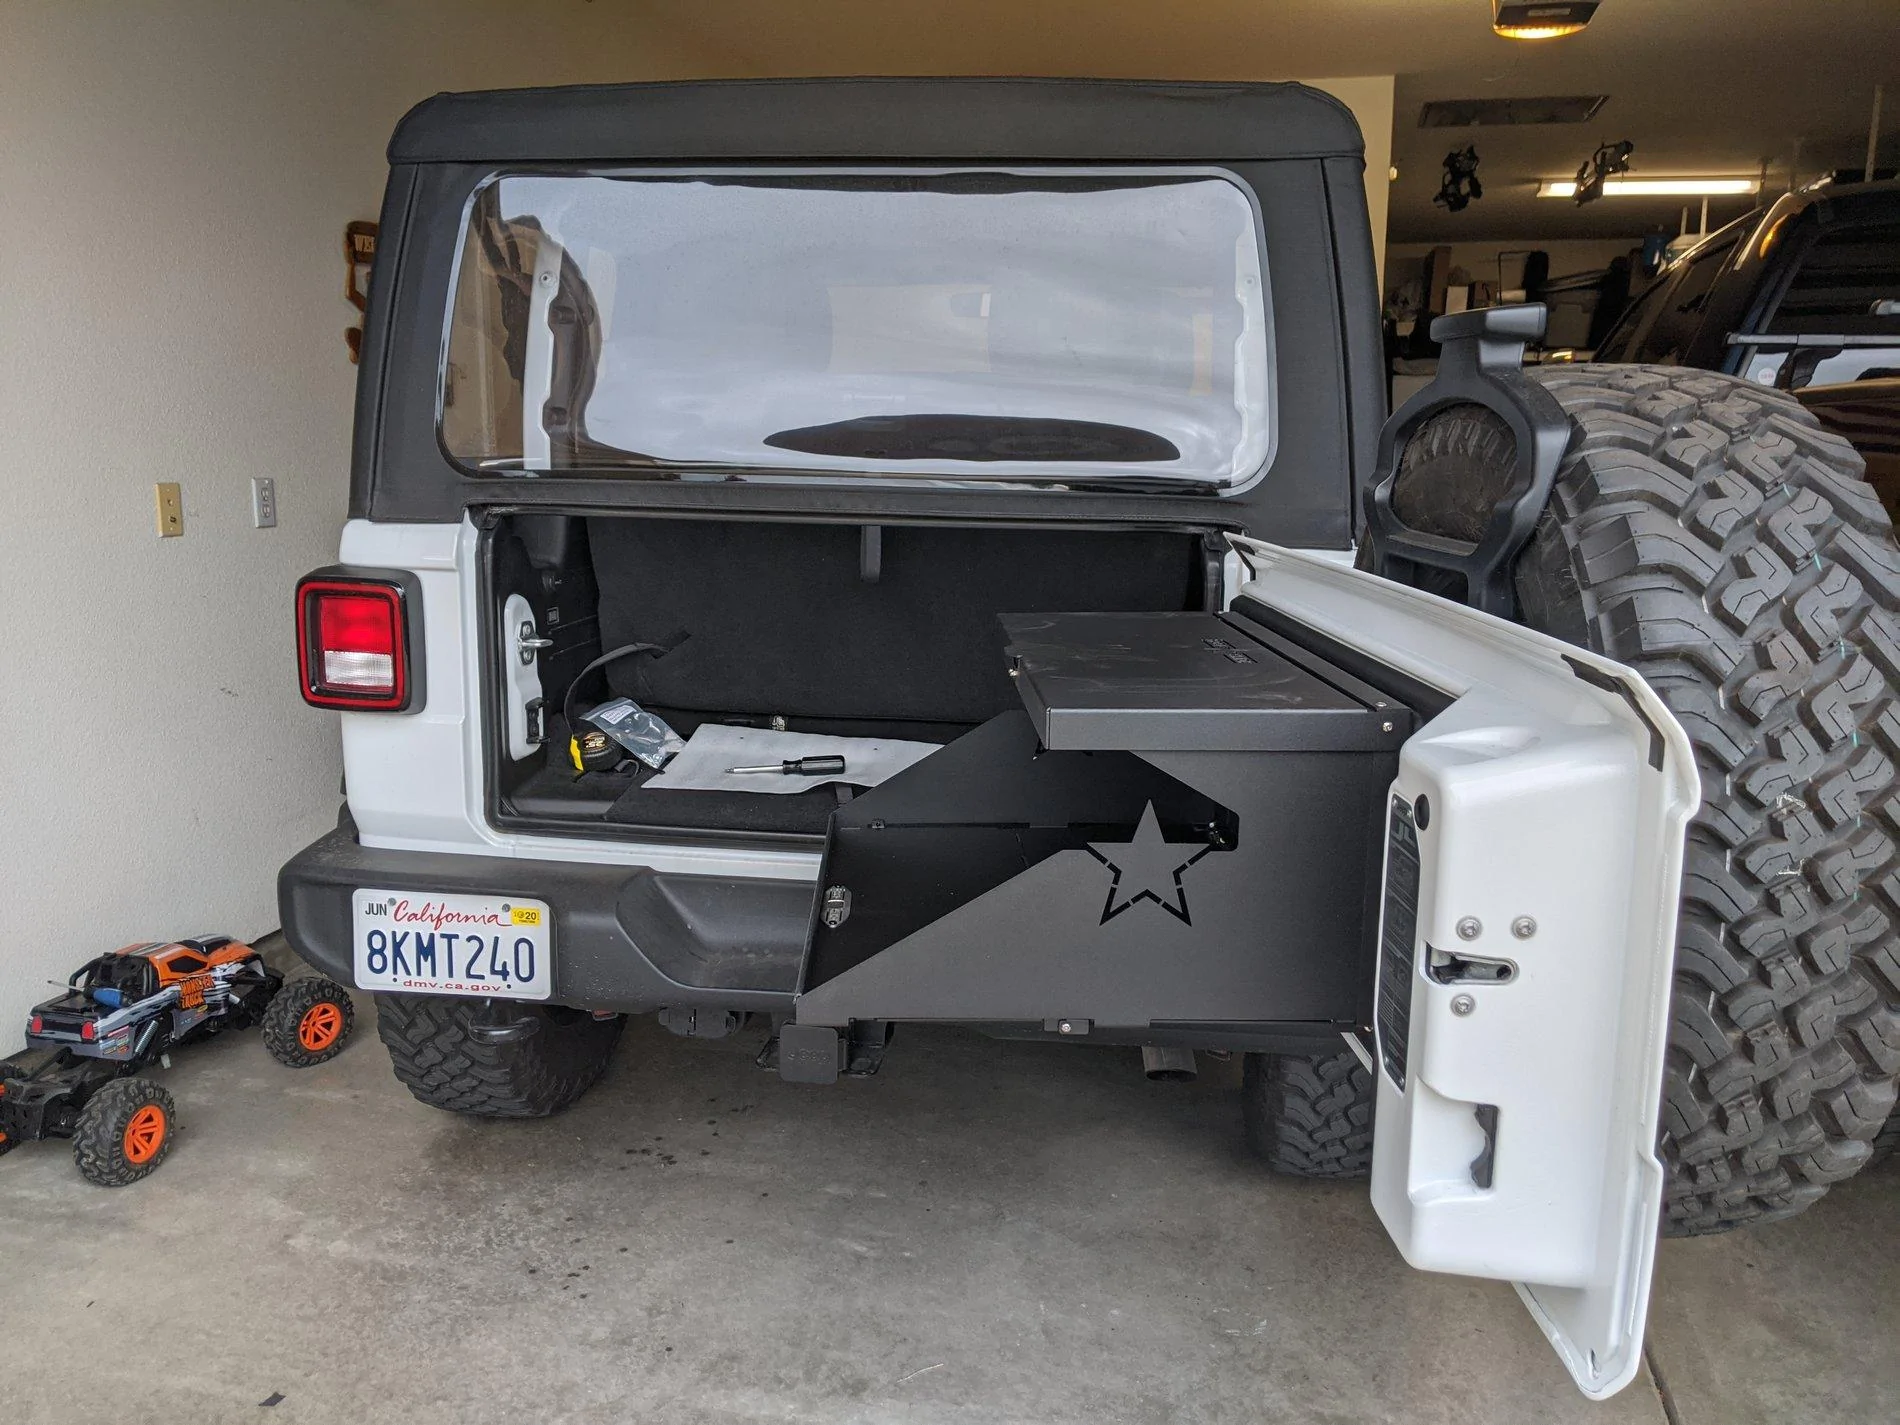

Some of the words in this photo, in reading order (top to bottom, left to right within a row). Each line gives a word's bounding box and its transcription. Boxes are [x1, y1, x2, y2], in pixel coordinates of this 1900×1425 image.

[365, 902, 388, 916] JUN
[393, 899, 512, 930] California
[525, 911, 537, 921] 20
[366, 929, 535, 983] 8KMT240
[403, 979, 501, 992] dmv.ca.gov
[181, 990, 206, 1010] TRUCK
